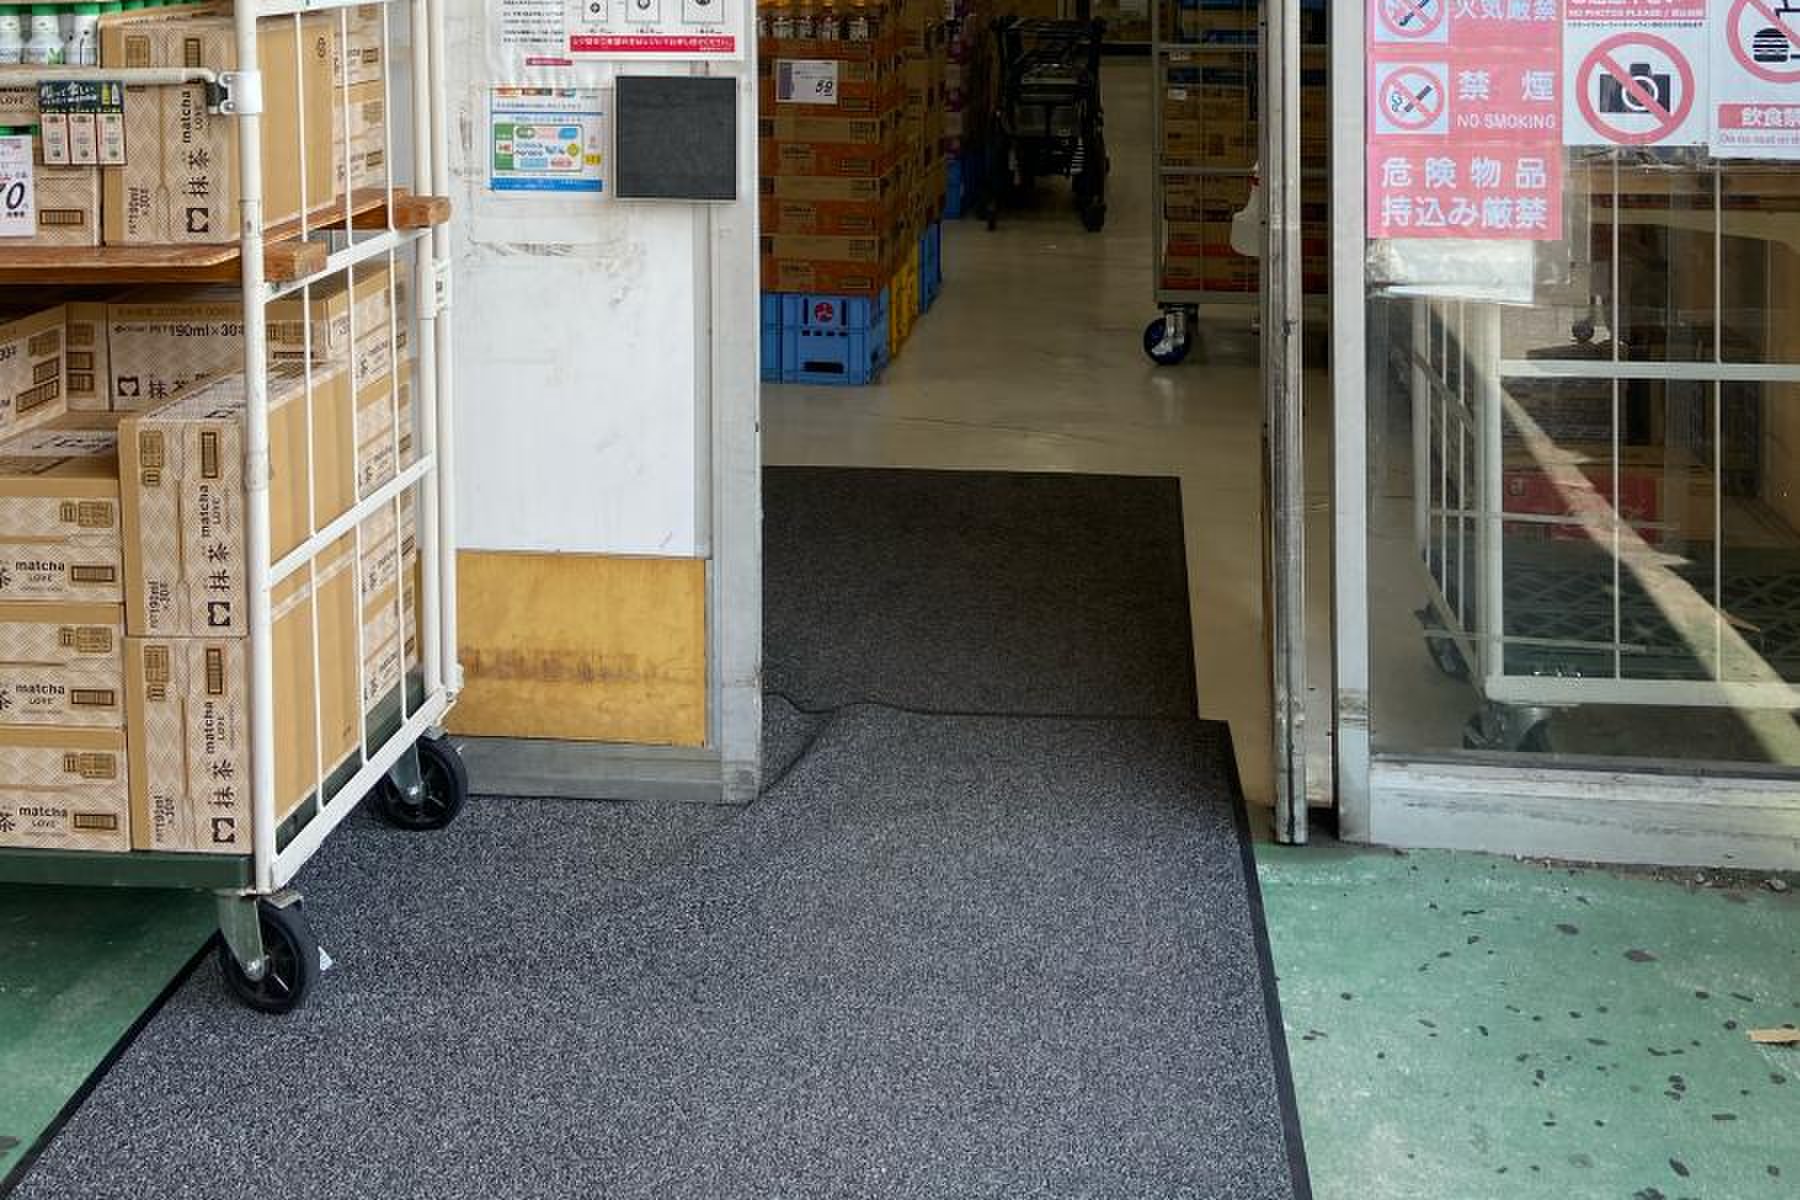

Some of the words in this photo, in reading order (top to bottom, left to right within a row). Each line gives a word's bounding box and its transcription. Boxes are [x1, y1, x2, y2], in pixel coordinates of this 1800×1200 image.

[1483, 113, 1556, 129] SMOKING
[1381, 156, 1547, 189] 危険物品
[1381, 196, 1548, 229] 持込み厳禁
[15, 561, 65, 571] matcha
[15, 684, 65, 695] matcha
[19, 805, 68, 817] matcha
